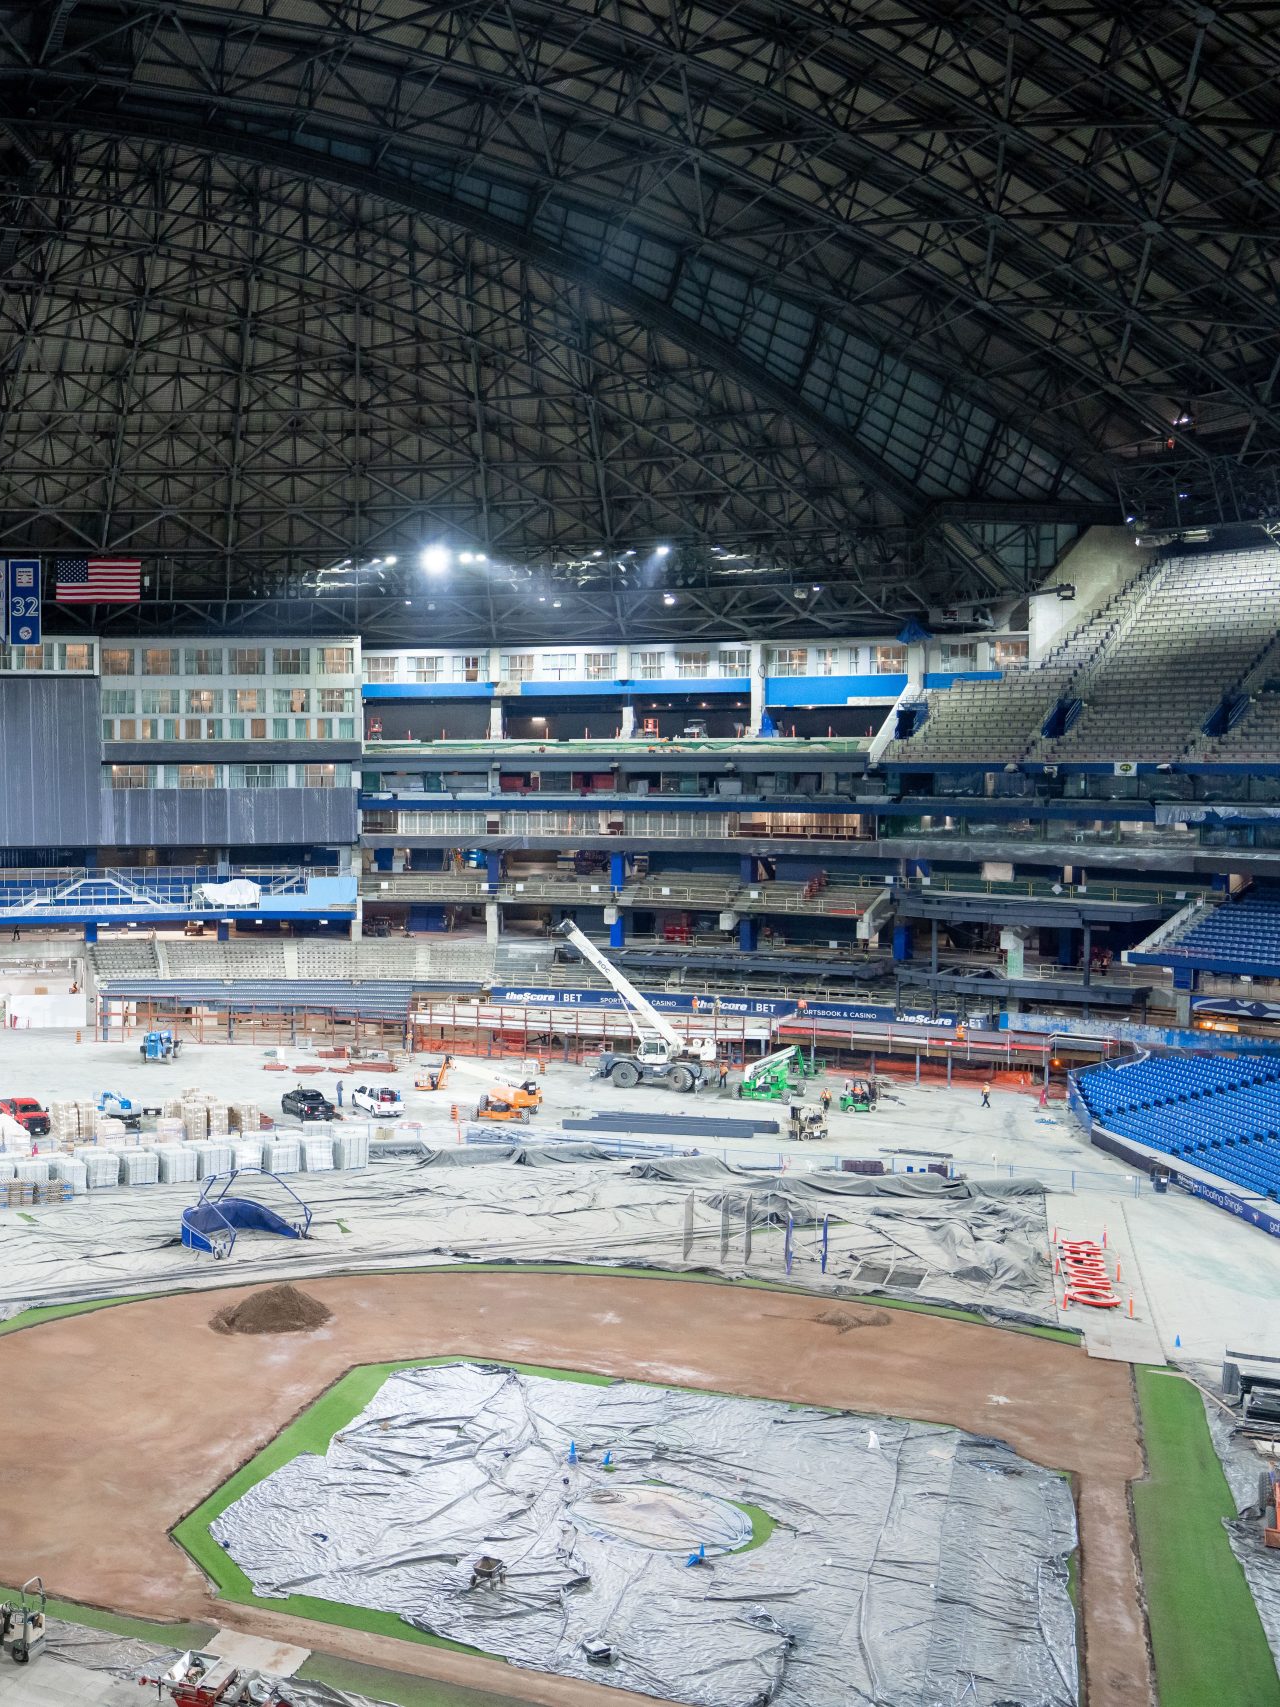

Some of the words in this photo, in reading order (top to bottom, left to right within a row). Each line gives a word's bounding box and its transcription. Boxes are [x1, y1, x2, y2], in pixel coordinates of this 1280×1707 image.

[12, 597, 39, 617] 32
[506, 992, 555, 1001] theScore
[564, 993, 582, 1002] BET
[756, 1003, 776, 1013] BET
